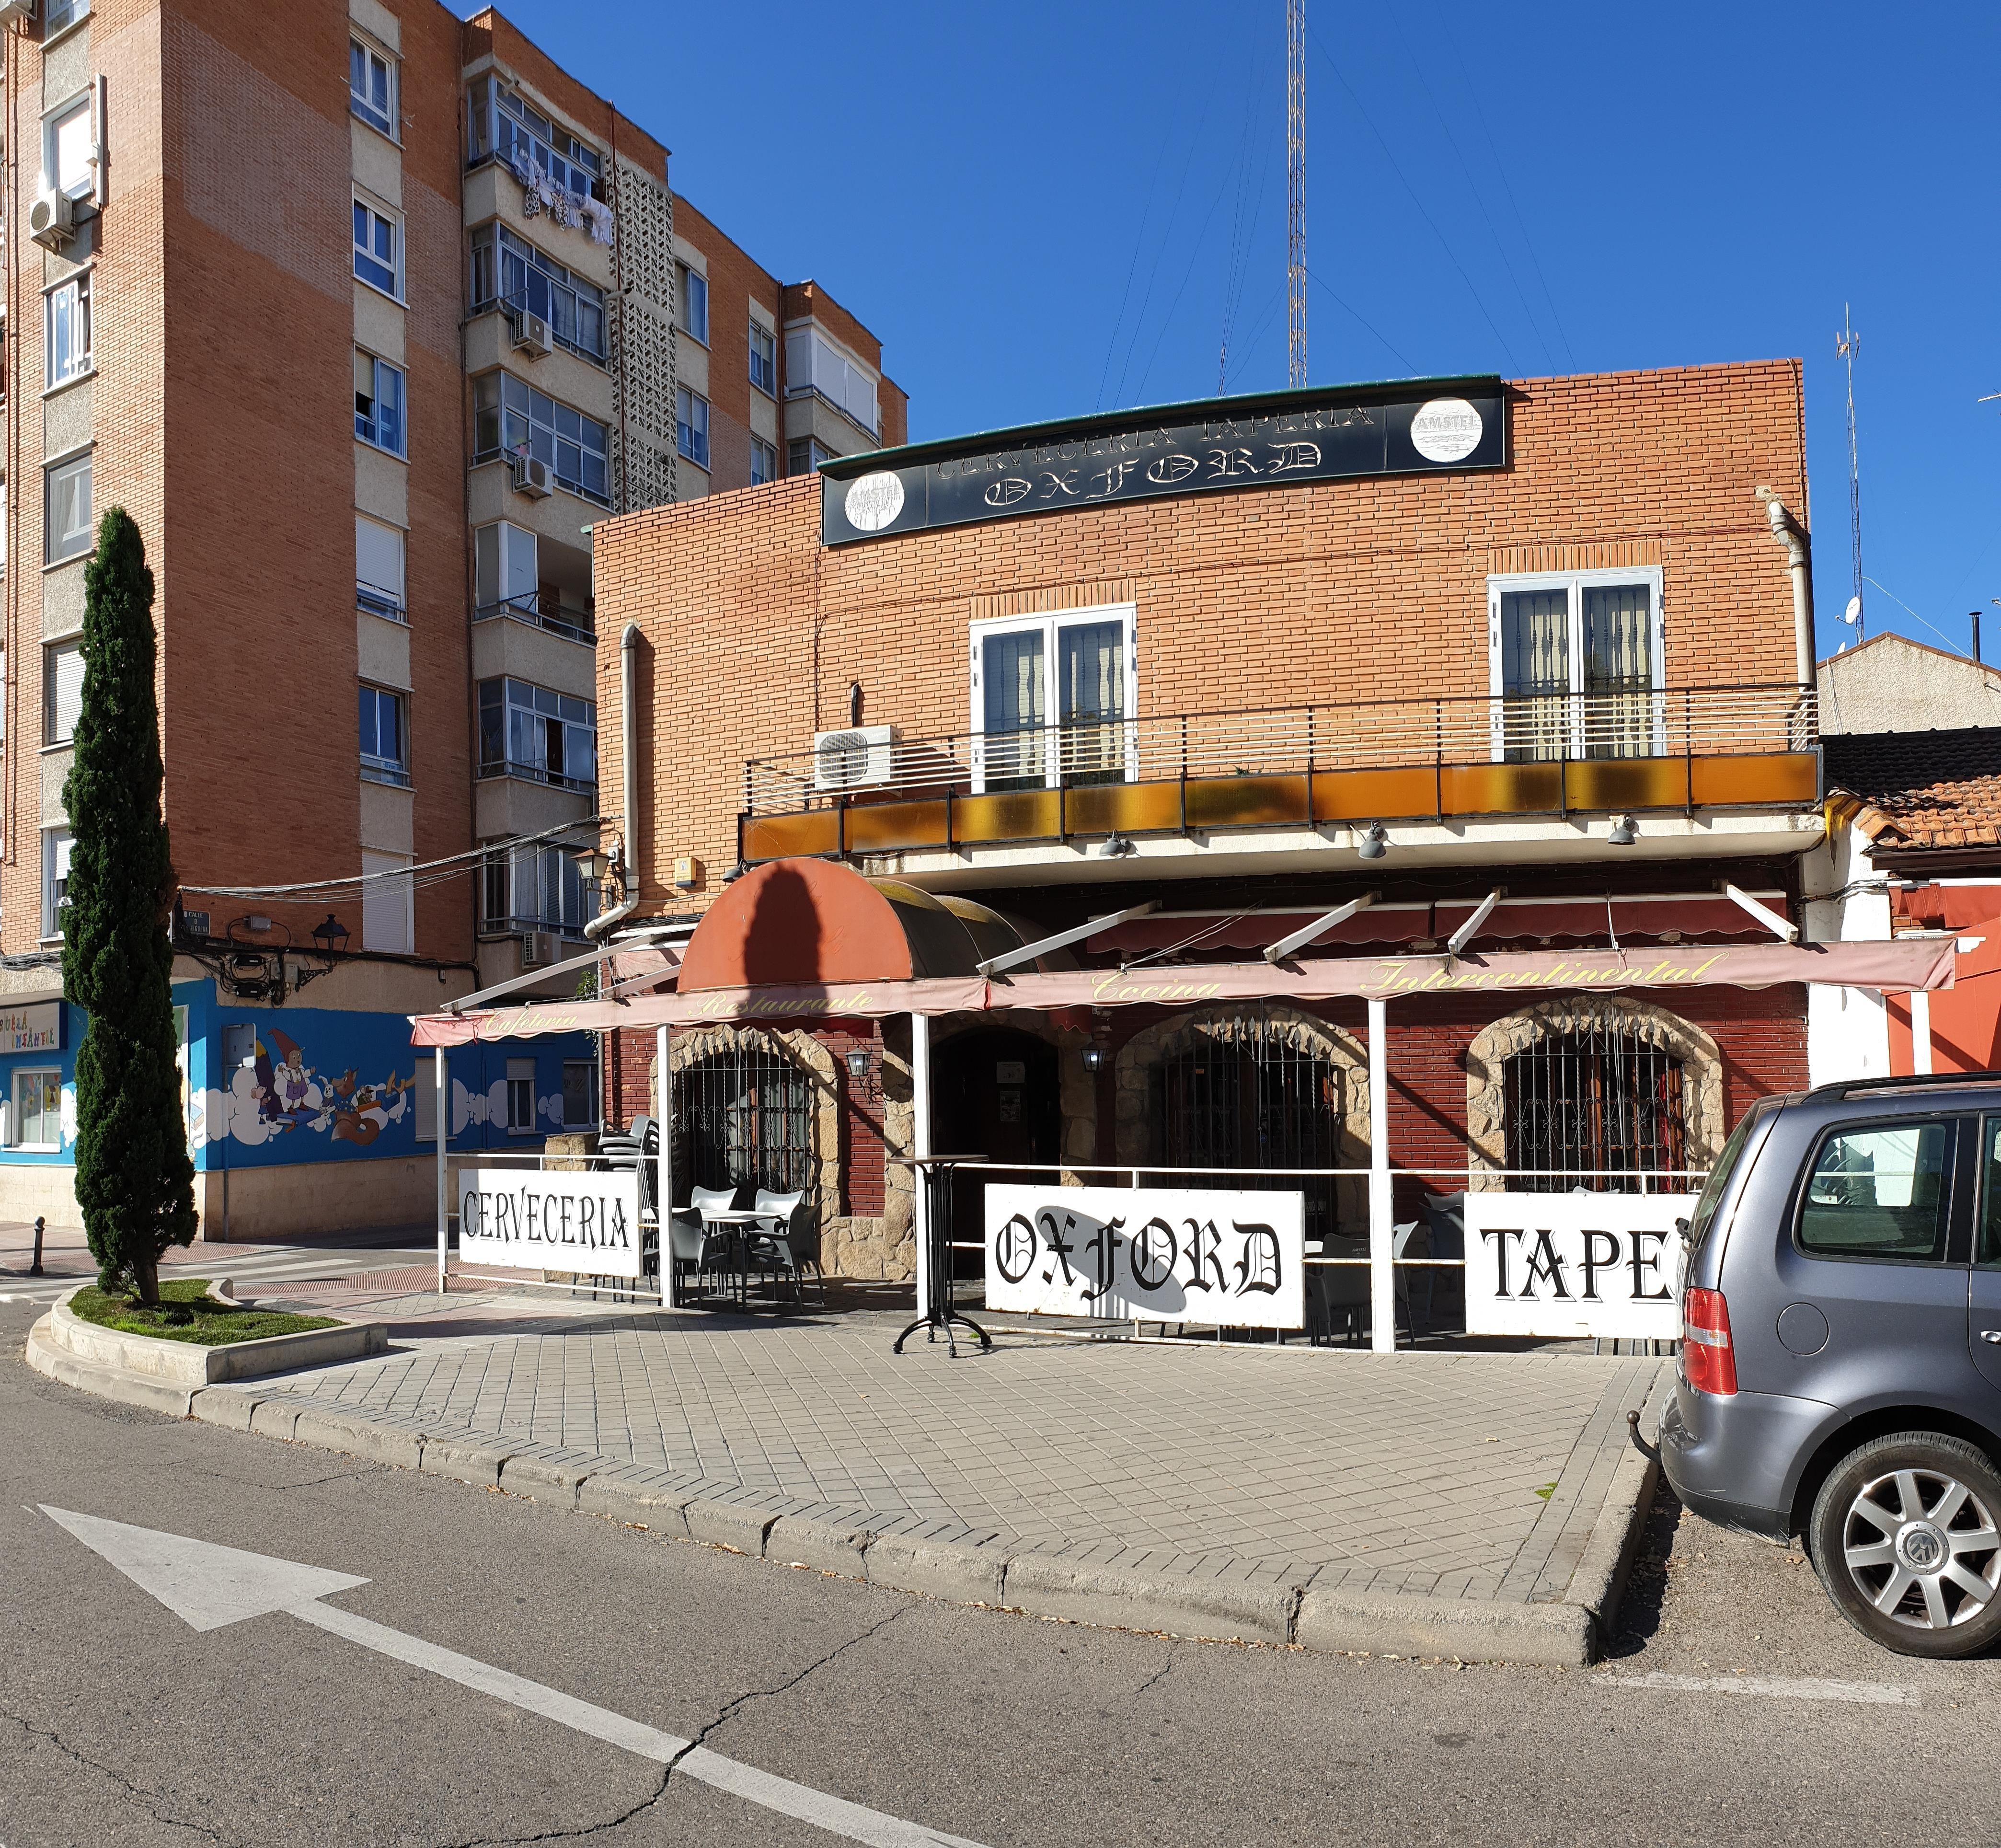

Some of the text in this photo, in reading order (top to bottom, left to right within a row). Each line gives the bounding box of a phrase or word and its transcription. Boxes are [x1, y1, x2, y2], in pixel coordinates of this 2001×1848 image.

[936, 404, 1374, 480] CERVECERIA TAPERIA
[1416, 415, 1475, 430] AMSTEL
[984, 441, 1322, 506] OXFORD
[688, 990, 874, 1017] Restaurante
[1092, 972, 1222, 1001] Cocina
[1359, 952, 1731, 991] Intercontinental
[11, 1027, 55, 1049] INFANTIL
[463, 1184, 632, 1253] CERVECERIA
[996, 1213, 1282, 1301] OXFORD
[1479, 1229, 1676, 1304] TAPE
